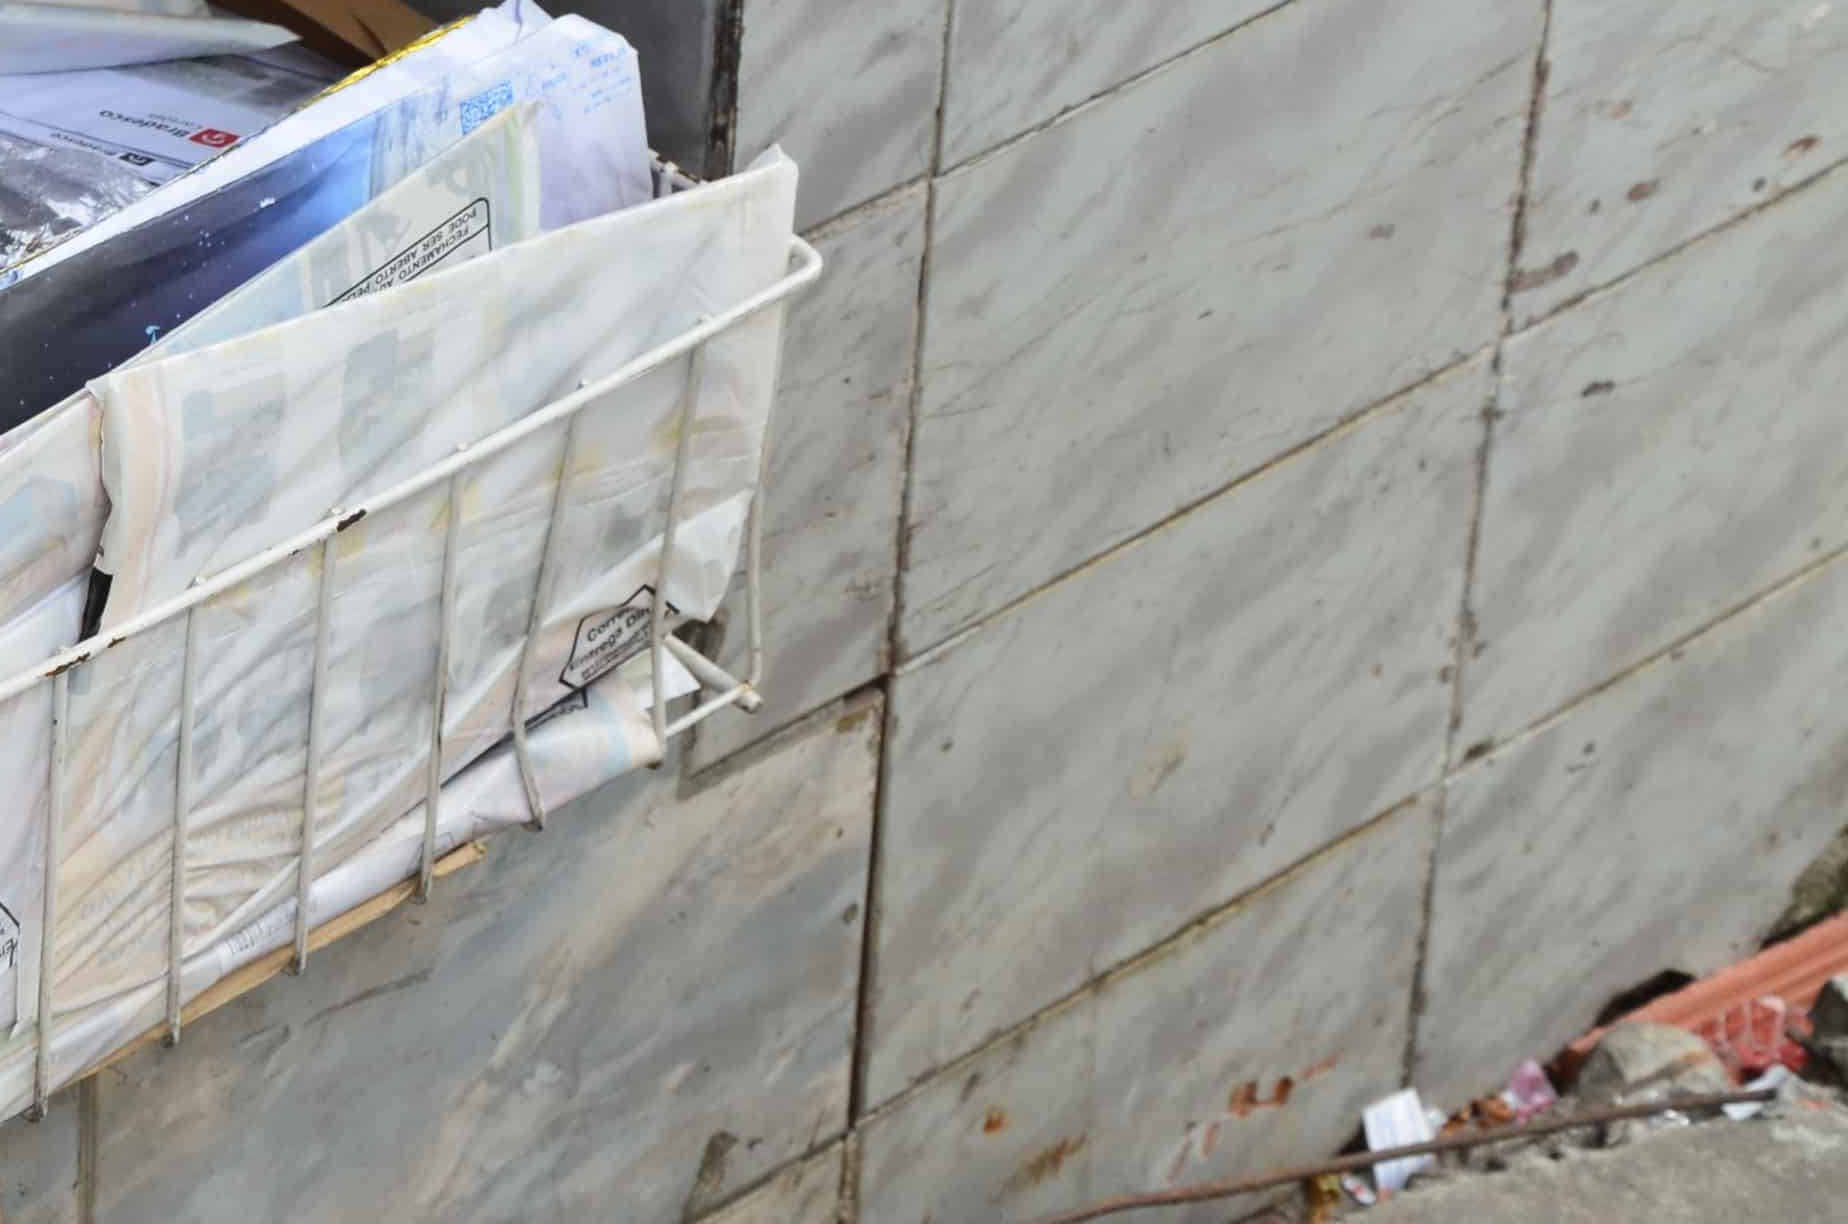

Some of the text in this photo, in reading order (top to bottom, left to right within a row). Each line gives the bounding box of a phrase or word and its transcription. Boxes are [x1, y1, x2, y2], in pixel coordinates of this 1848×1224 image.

[398, 226, 471, 281] FECHAMENTO
[422, 231, 444, 251] SER
[375, 249, 418, 284] ABERTO
